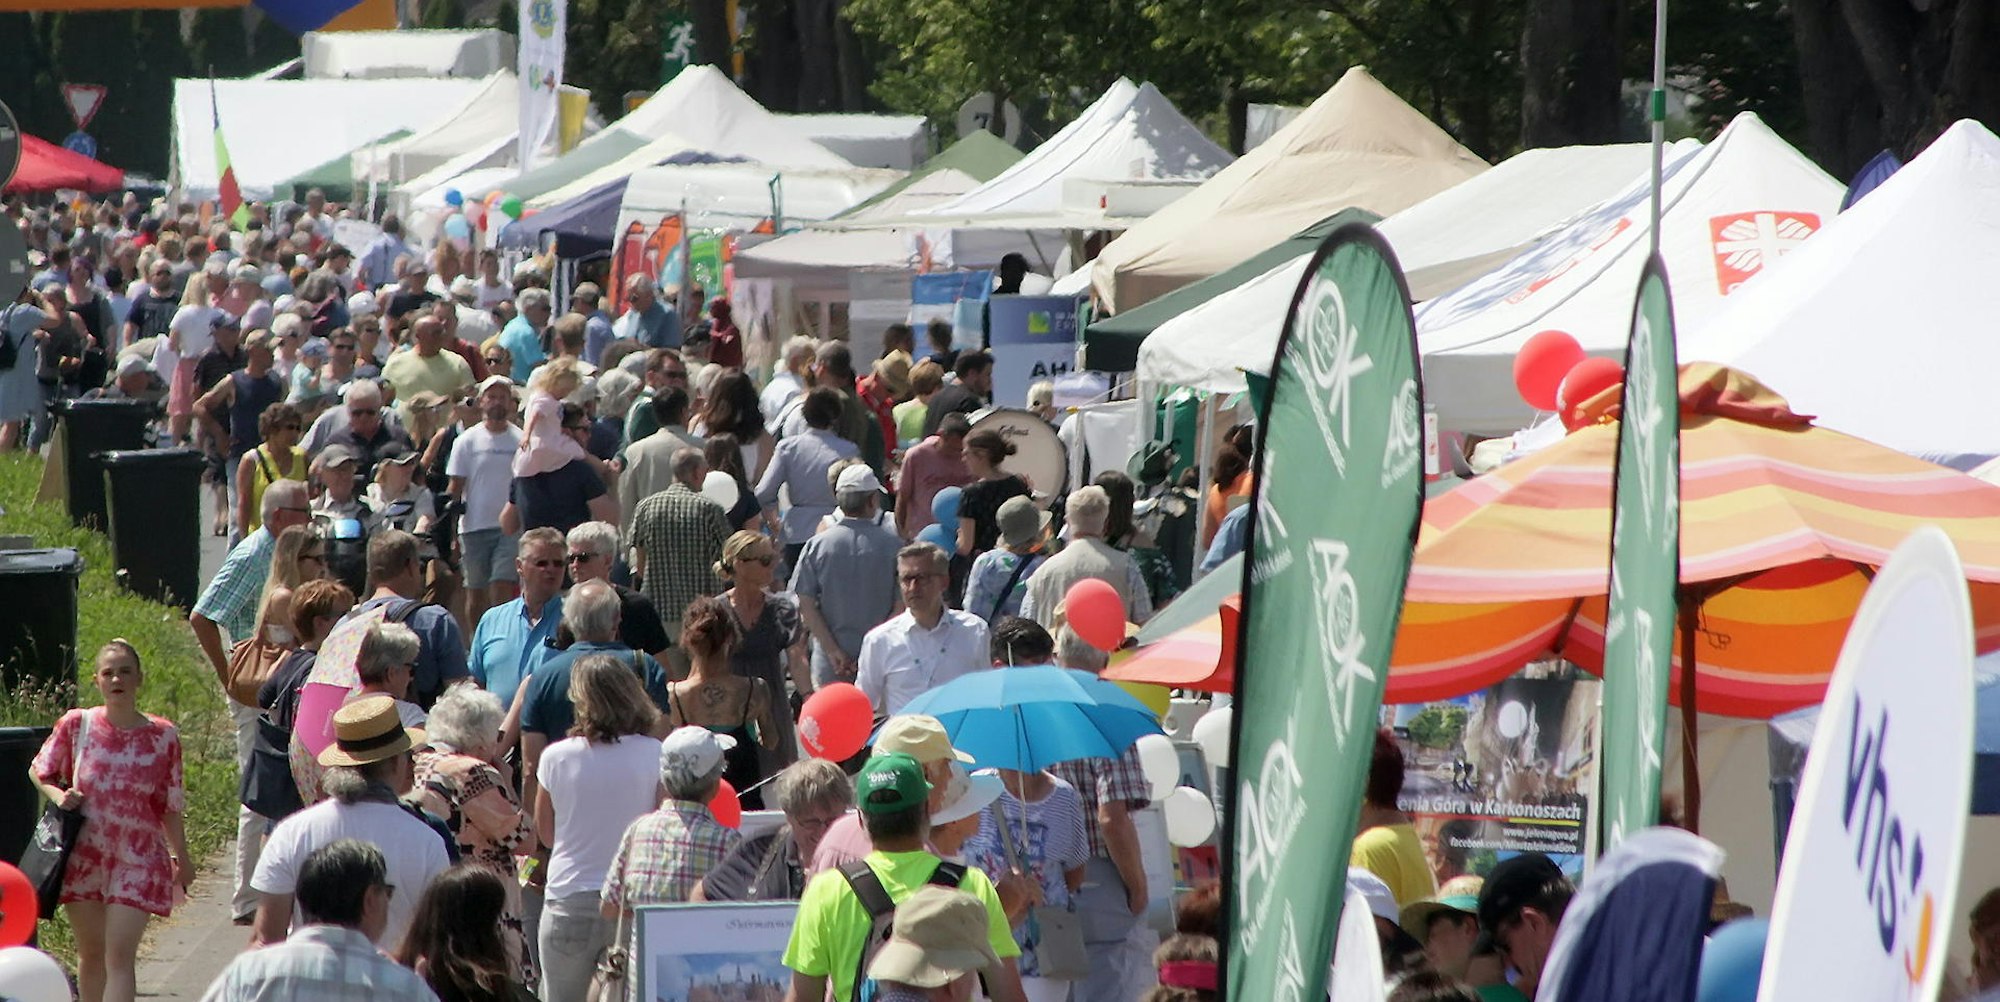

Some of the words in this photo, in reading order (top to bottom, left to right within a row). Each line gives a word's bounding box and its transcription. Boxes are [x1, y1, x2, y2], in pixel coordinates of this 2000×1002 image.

[1431, 798, 1466, 815] Góra
[1470, 803, 1483, 815] w
[1485, 801, 1580, 820] Karkonoszach
